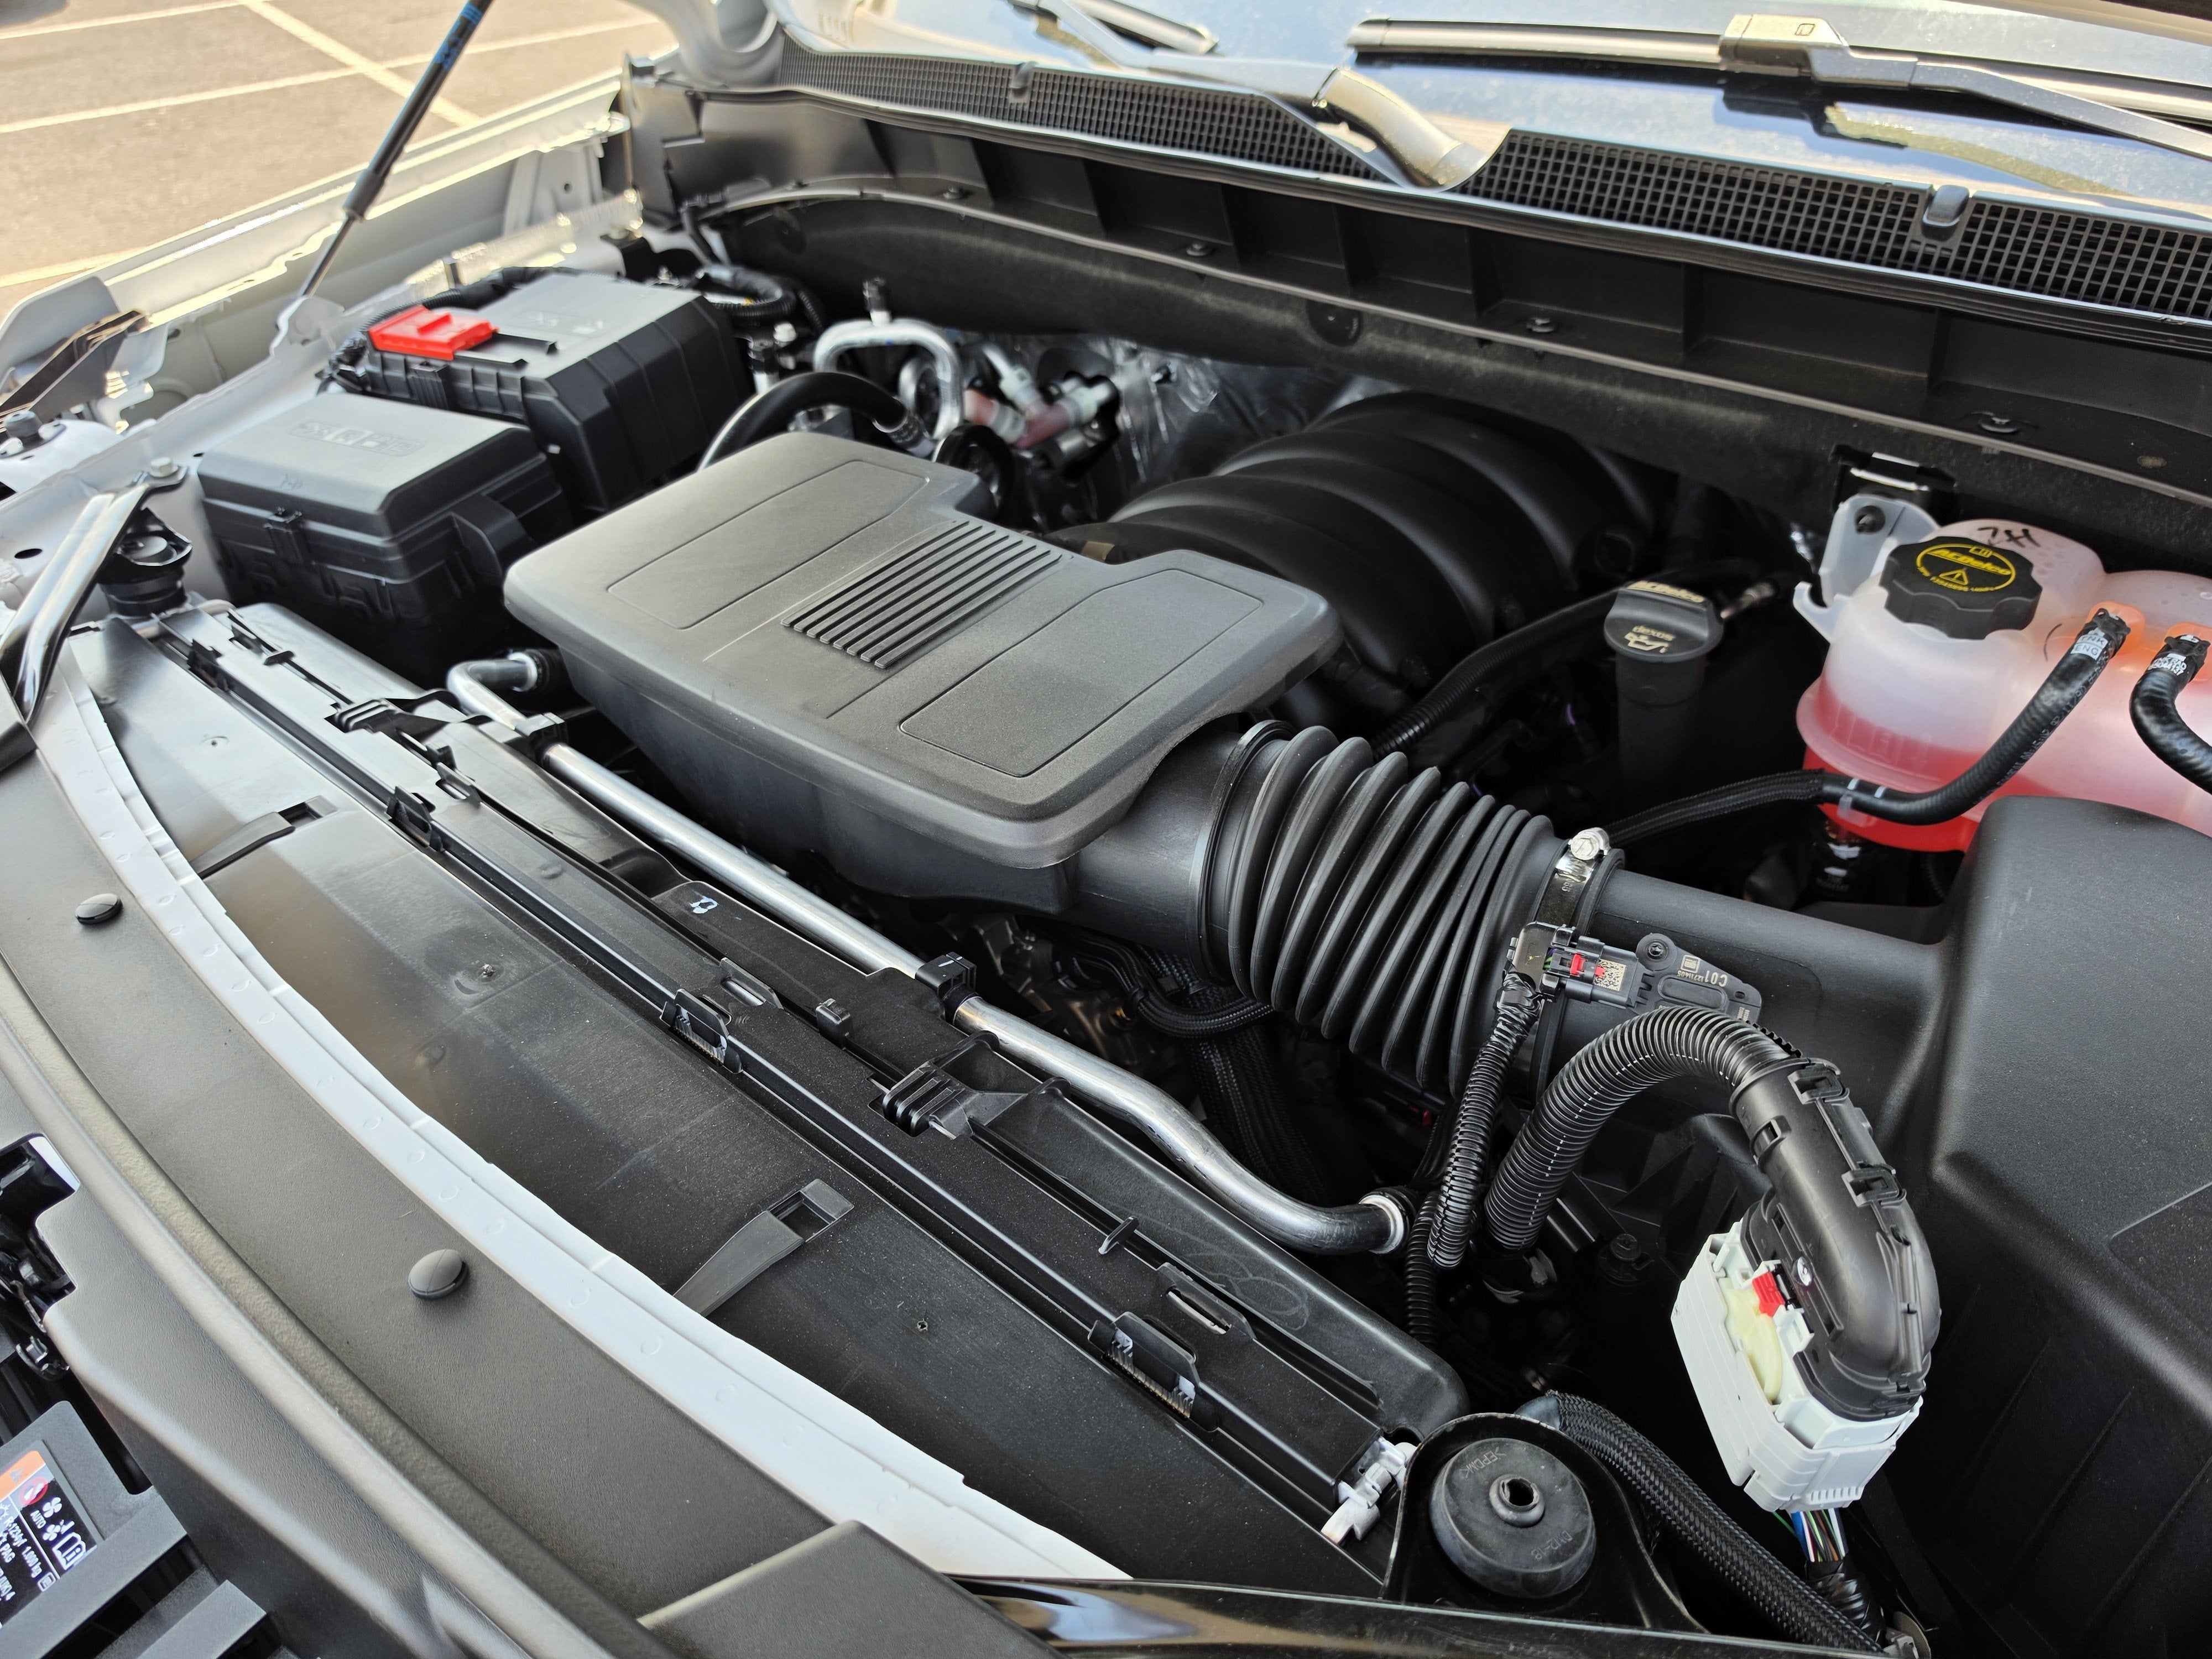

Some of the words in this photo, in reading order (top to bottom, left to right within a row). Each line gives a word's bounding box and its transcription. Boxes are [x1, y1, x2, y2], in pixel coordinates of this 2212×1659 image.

[2074, 644, 2099, 656] ENG
[1704, 970, 1728, 987] C01
[30, 1510, 46, 1529] AUTO
[0, 1543, 16, 1563] PAG
[22, 1546, 39, 1567] 1.000
[31, 1562, 43, 1578] kg
